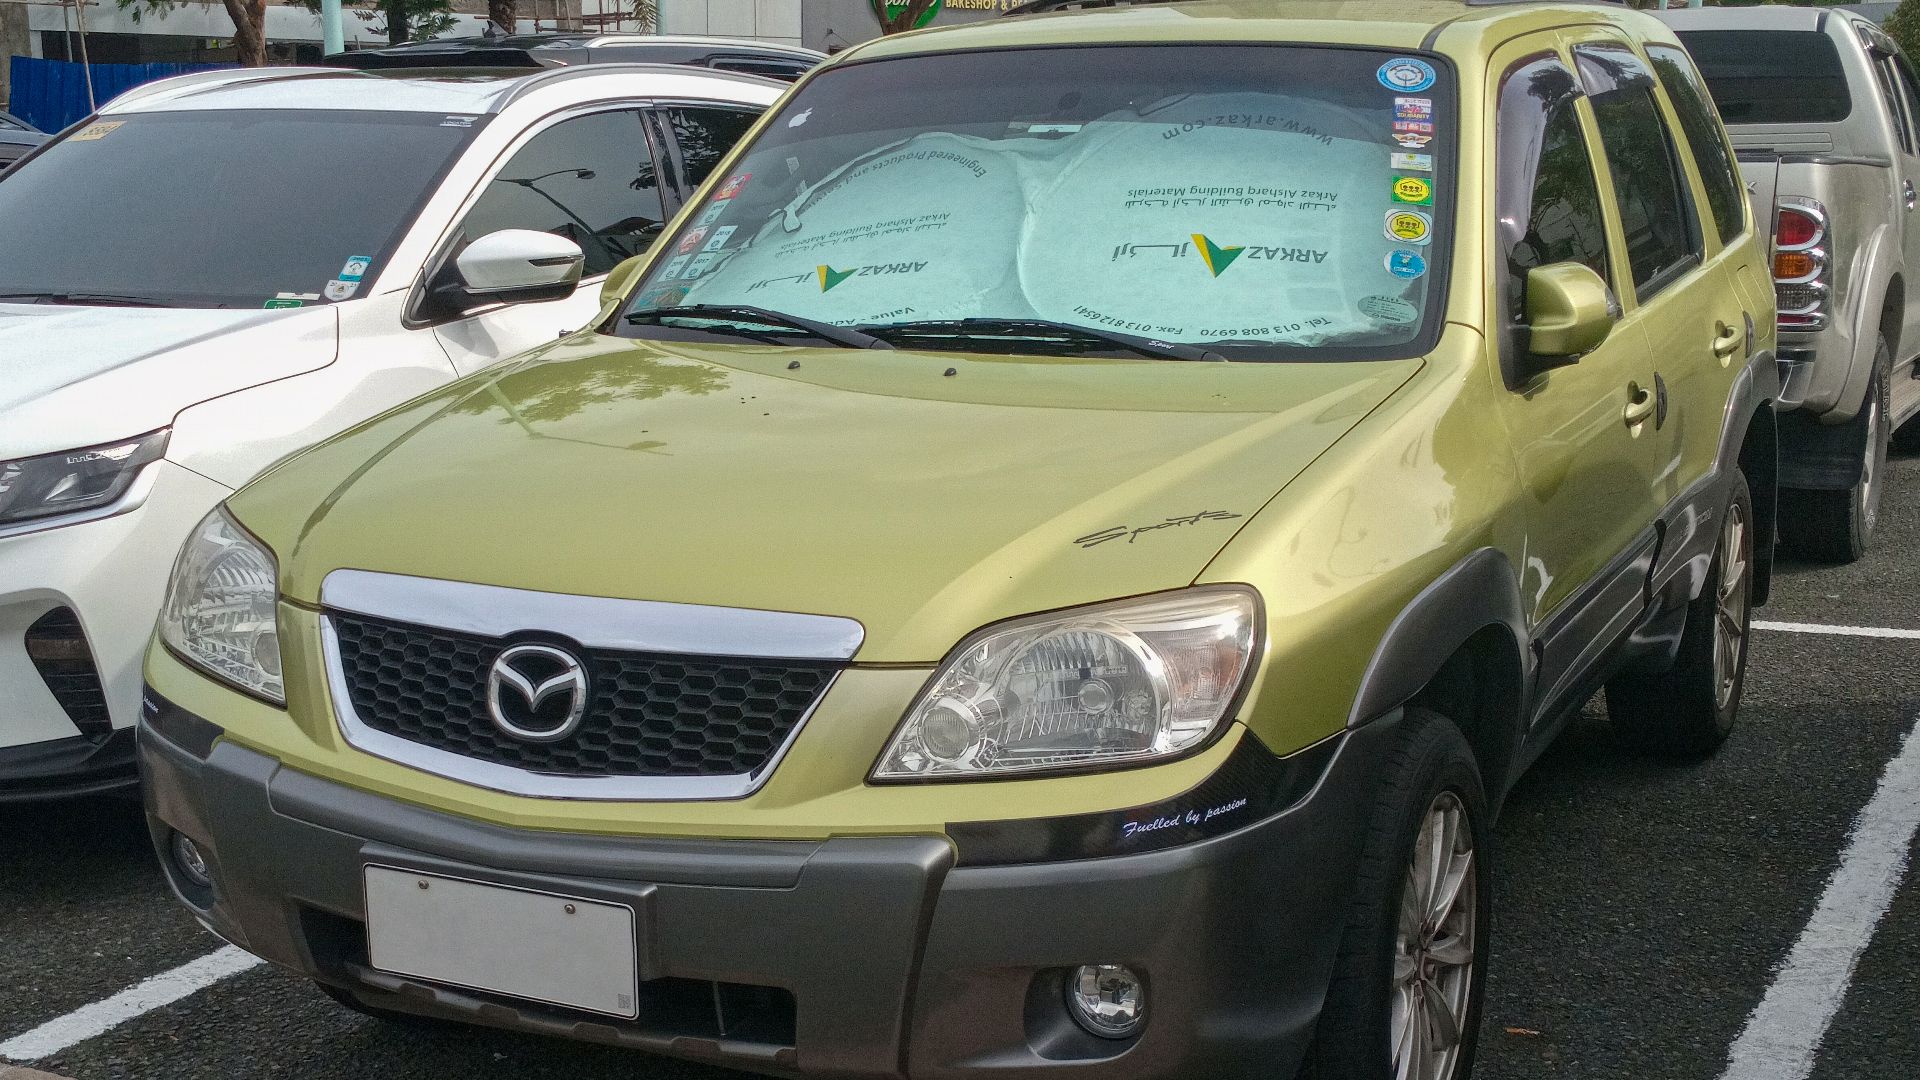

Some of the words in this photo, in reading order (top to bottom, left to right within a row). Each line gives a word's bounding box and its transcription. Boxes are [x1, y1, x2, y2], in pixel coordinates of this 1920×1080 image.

[946, 0, 997, 10] BAKESHOP
[1162, 113, 1334, 146] www.arkaz.com
[872, 150, 928, 172] Products
[928, 150, 987, 178] Engineered
[845, 167, 872, 185] and
[1127, 187, 1185, 197] Materials
[1189, 185, 1243, 198] Building
[1248, 187, 1297, 201] Alsharq
[1301, 191, 1338, 202] Arkaz
[875, 217, 918, 230] Alsharq
[919, 212, 951, 224] Arkaz
[828, 224, 873, 238] Building
[781, 234, 827, 250] Materials
[1247, 246, 1329, 263] ARKAZ
[857, 260, 929, 277] ARKAZ
[870, 306, 916, 322] Value
[1124, 322, 1151, 332] 013
[1304, 316, 1332, 327] Tel.
[1156, 326, 1183, 335] Fax.
[1200, 328, 1238, 337] 6970
[1243, 327, 1270, 336] 808
[1274, 323, 1300, 334] 013
[1123, 814, 1181, 838] Fuelled
[1185, 809, 1201, 825] by
[1204, 797, 1247, 822] passion
